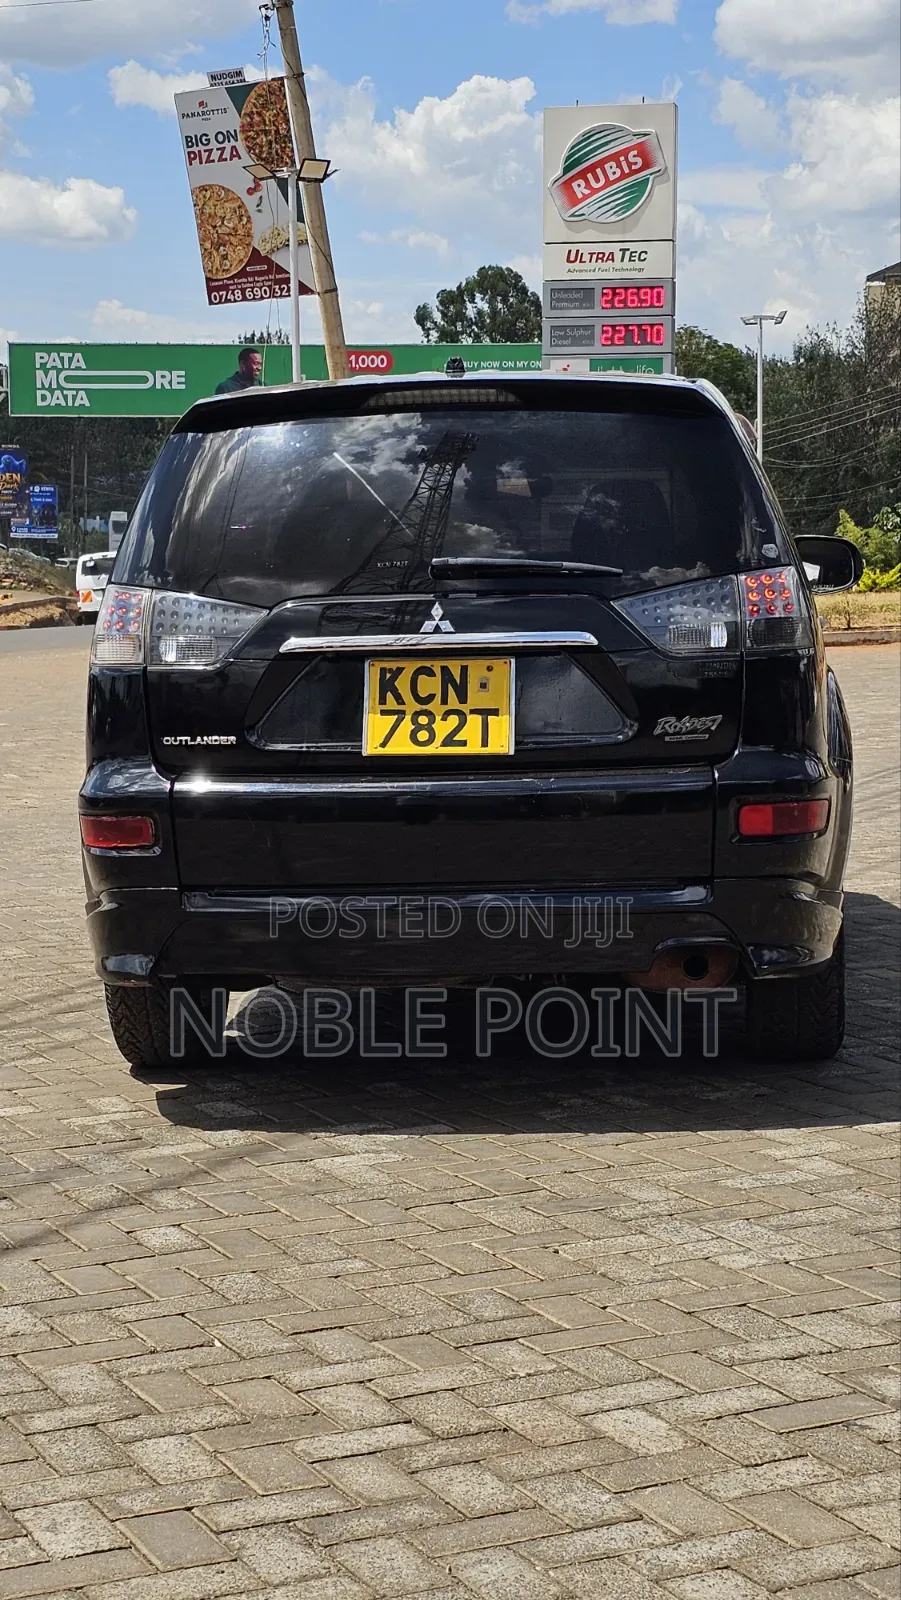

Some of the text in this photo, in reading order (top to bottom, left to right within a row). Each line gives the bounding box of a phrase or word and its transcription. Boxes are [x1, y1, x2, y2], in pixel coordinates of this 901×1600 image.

[210, 70, 243, 82] NUDGIM
[181, 108, 228, 120] PANAROTTIS
[184, 129, 239, 149] BIG ON
[187, 145, 242, 166] PIZZA
[566, 248, 648, 264] ULTRA TEC
[612, 266, 646, 274] Technology
[211, 289, 242, 303] 0748
[245, 287, 270, 300] 690
[551, 290, 584, 299] Unleaded
[601, 287, 665, 309] 226.90
[551, 328, 592, 338] Low Sulphur
[551, 337, 571, 345] Diesel
[601, 324, 665, 346] 227.70
[35, 352, 87, 369] PATA
[348, 354, 388, 370] 1,000
[35, 370, 186, 390] MORE
[36, 390, 91, 407] DATA
[378, 664, 469, 706] KCN
[379, 708, 500, 749] 782T
[162, 735, 237, 745] OUTLANDER
